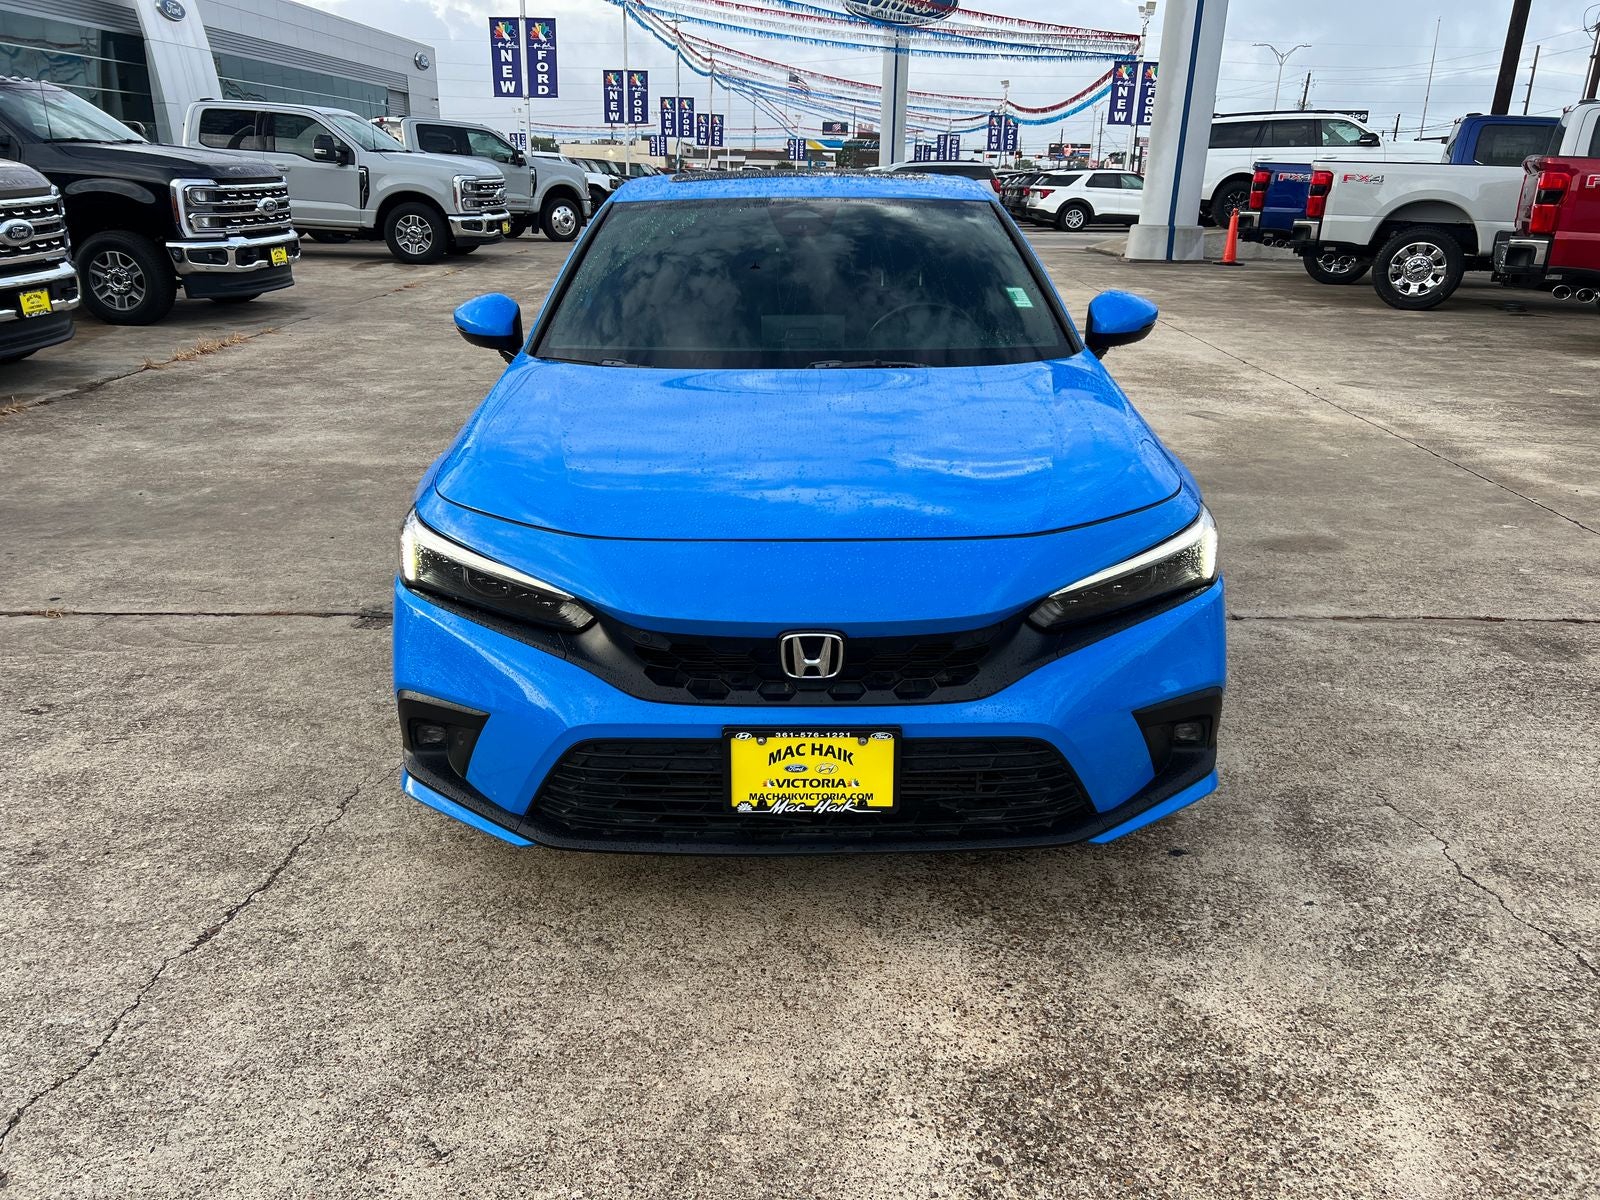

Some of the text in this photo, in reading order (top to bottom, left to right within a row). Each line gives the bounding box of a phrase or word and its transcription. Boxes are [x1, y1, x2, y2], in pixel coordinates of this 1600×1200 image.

[500, 49, 516, 93] NEW
[536, 50, 549, 95] FORD
[608, 91, 620, 121] NEW
[633, 91, 642, 122] FORD
[1113, 86, 1129, 122] NEW
[1143, 87, 1156, 123] FORD
[664, 112, 673, 135] NEW
[699, 126, 707, 145] NEW
[990, 129, 998, 149] NEW
[1342, 173, 1385, 182] FX4
[12, 226, 28, 238] Ford
[768, 743, 854, 766] MAC HAIK
[787, 764, 804, 772] Ford
[775, 778, 847, 788] VICTORIA
[749, 792, 874, 801] MACHAIKVICTORIA.COM
[768, 798, 857, 814] Mac Haik
